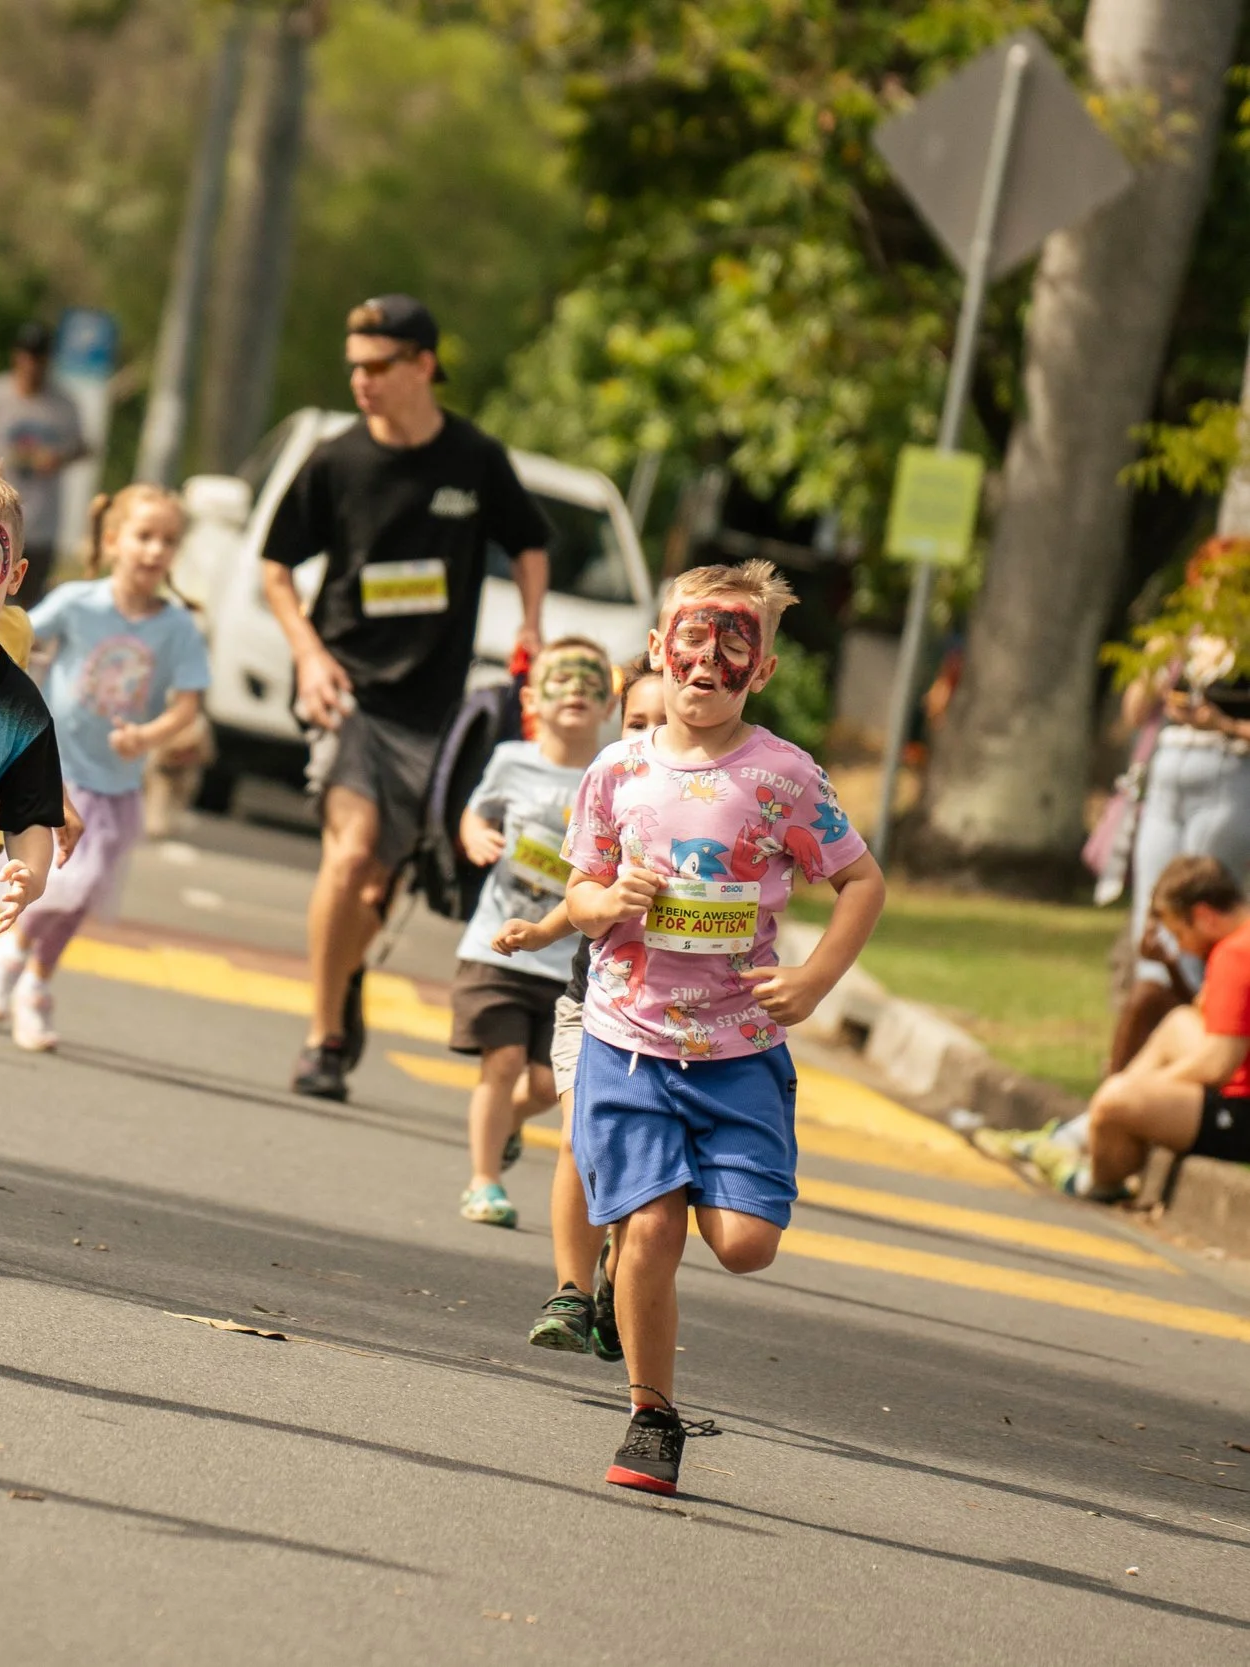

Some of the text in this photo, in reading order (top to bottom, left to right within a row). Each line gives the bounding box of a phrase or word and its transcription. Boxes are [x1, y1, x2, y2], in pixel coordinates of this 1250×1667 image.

[666, 907, 700, 919] BEING
[702, 910, 755, 920] AWESOME
[656, 915, 747, 934] FOR AUTISM
[670, 987, 710, 1001] TAILS
